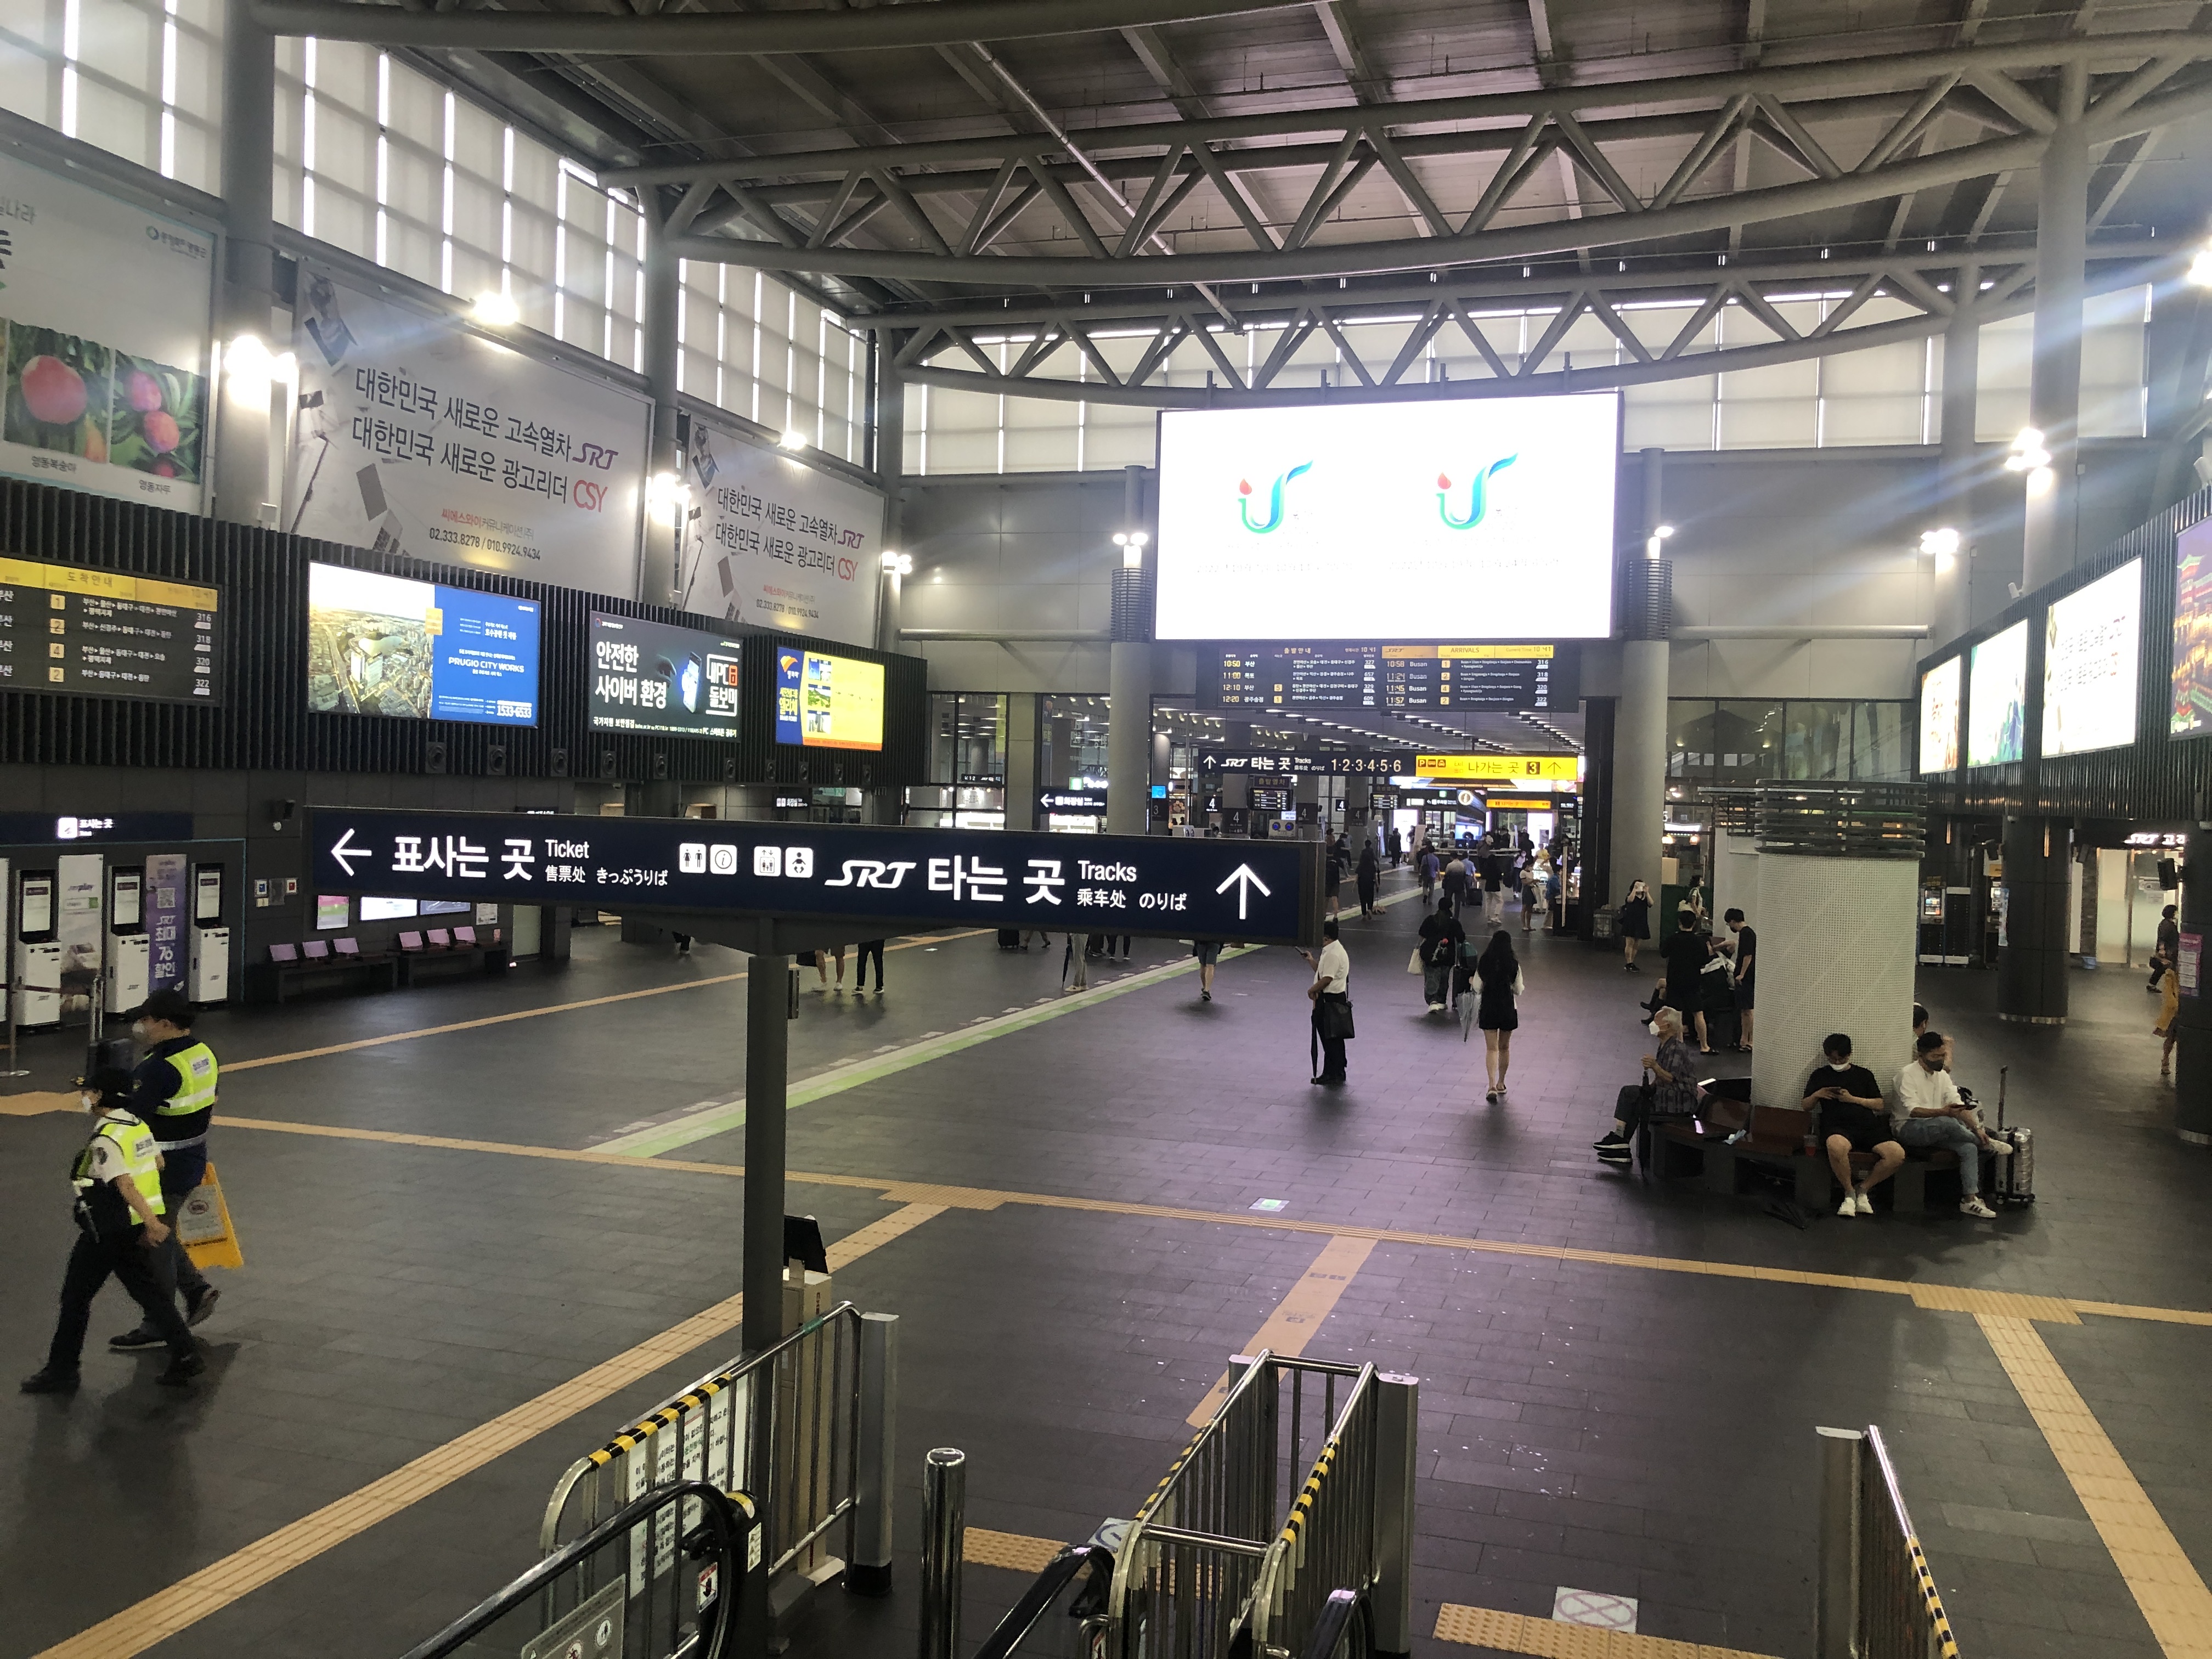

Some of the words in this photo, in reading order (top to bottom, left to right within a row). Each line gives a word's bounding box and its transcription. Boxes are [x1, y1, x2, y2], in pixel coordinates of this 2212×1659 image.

[356, 368, 438, 420] 대한민국
[443, 397, 500, 439] 새로운
[504, 417, 571, 462] 고속열차
[572, 443, 619, 470] SRT
[31, 455, 77, 473] 영동복숭아
[352, 416, 435, 466] 대한민국
[440, 442, 496, 483] 새로운
[501, 458, 568, 504] 광고리더
[573, 479, 608, 512] CSY
[139, 479, 172, 494] 영동자두
[718, 487, 762, 521] 대한민국
[765, 503, 797, 532] 새로운
[799, 515, 838, 545] 고속열차
[837, 529, 865, 549] SRT
[429, 527, 481, 549] 02.333.8278
[487, 538, 541, 561] 010.9924.9434
[715, 522, 760, 555] 대한민국
[763, 535, 794, 565] 새로운
[797, 545, 836, 577] 광고리더
[837, 557, 858, 582] CSY
[55, 597, 60, 607] 1
[197, 612, 212, 622] 316
[196, 634, 211, 644] 318
[195, 657, 211, 666] 320
[448, 657, 479, 668] PRUGIO
[480, 661, 498, 670] CITY
[498, 663, 524, 673] WORKS
[596, 641, 639, 673] 안전한
[195, 679, 210, 688] 322
[595, 675, 637, 706] 사이버
[640, 679, 668, 709] 환경
[709, 686, 737, 709] 돌보미
[593, 716, 614, 727] 국가지원
[1221, 759, 1248, 767] SRT
[1251, 757, 1274, 771] 타는
[1278, 758, 1291, 771] 곳
[1468, 761, 1503, 774] 나가는
[1508, 762, 1520, 774] 곳
[1529, 762, 1537, 774] 3
[1154, 805, 1159, 815] 3
[1209, 798, 1215, 809] 4
[1339, 800, 1344, 809] 4
[1233, 811, 1239, 823] 4
[1301, 808, 1307, 818] 4
[1355, 810, 1360, 819] 4
[2124, 833, 2159, 844] SRT
[392, 835, 489, 878] 표사는
[500, 839, 535, 881] 곳
[544, 839, 590, 860] Ticket
[545, 865, 586, 883] 售票处
[596, 868, 668, 887] きっぷうりば
[825, 860, 917, 890] SRT
[928, 854, 1008, 901] 타는
[1023, 859, 1066, 906] 곳
[1077, 860, 1137, 883] Tracks
[1076, 888, 1127, 909] 乘车处
[1138, 892, 1187, 912] のりば
[156, 915, 176, 926] SRT
